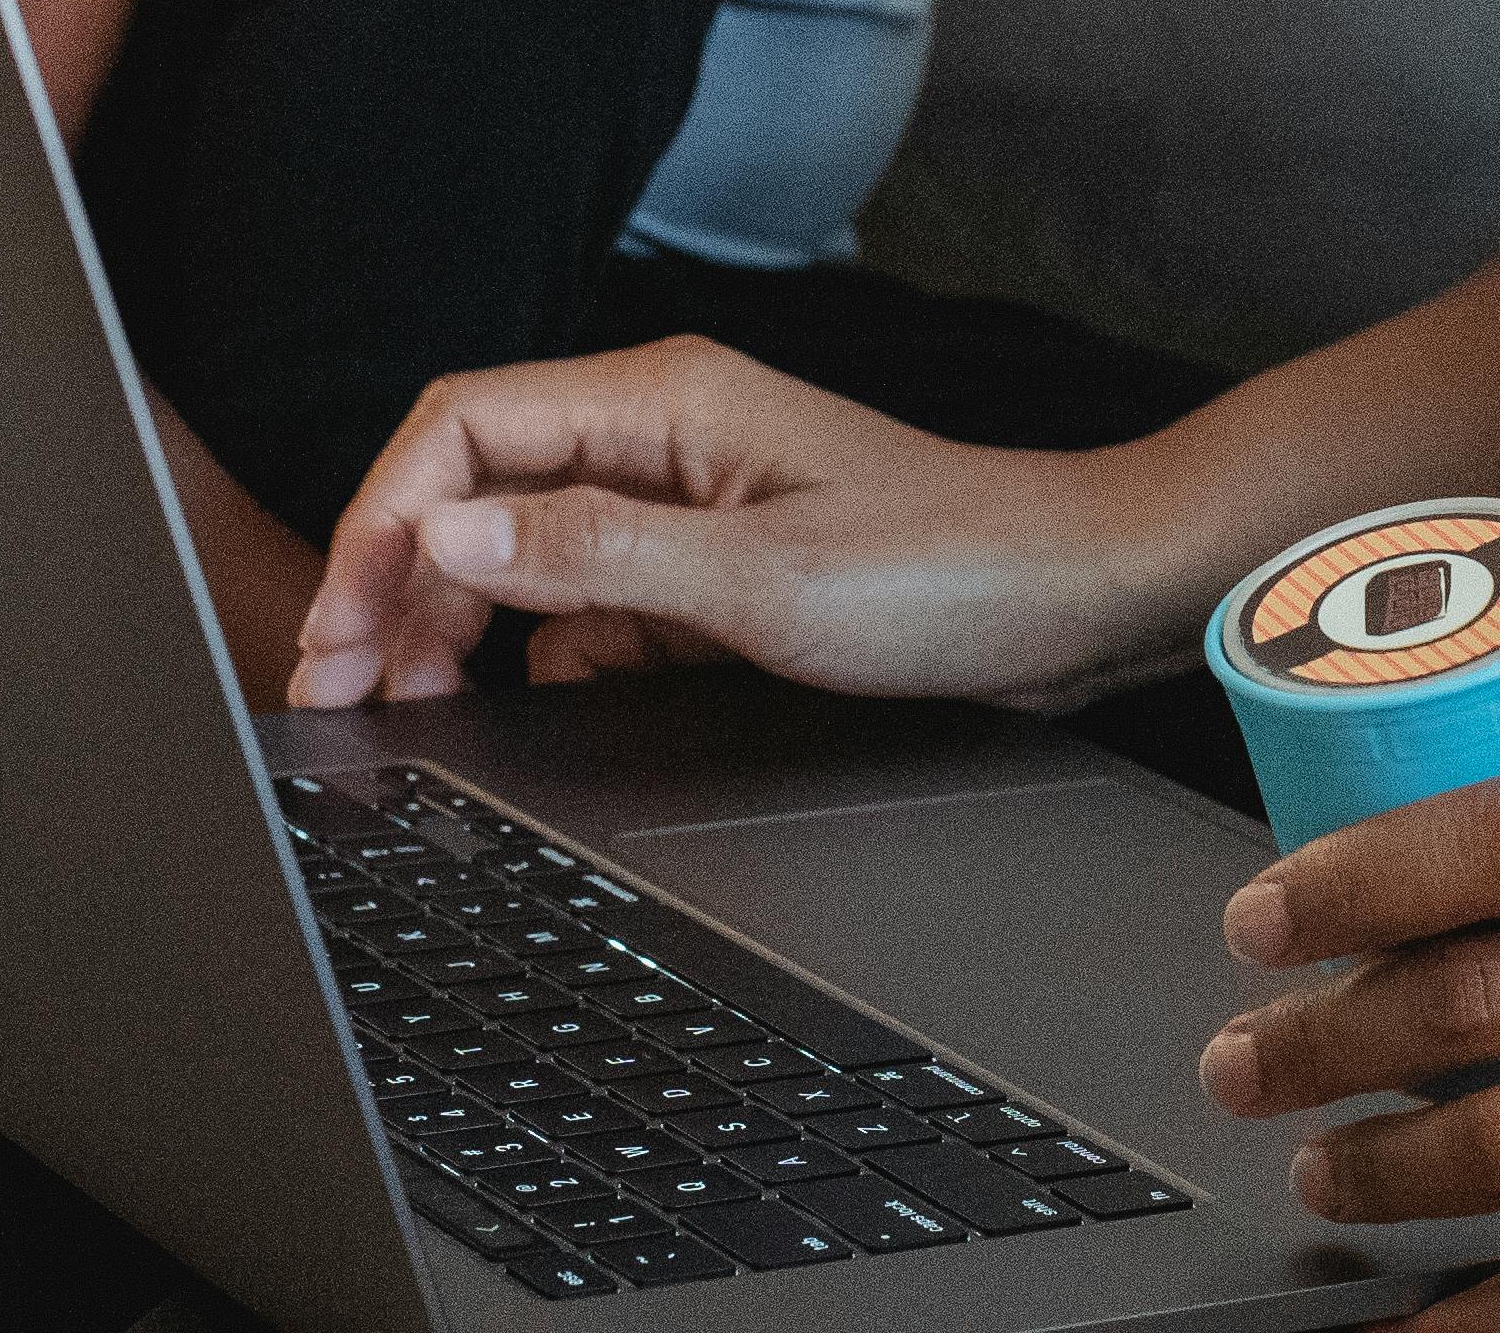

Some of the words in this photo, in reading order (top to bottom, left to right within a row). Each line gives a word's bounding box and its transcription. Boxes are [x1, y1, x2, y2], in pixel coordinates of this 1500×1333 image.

[921, 1063, 985, 1097] command
[999, 1105, 1043, 1129] option
[1056, 1140, 1107, 1165] control
[1150, 1190, 1170, 1201] fn
[884, 1199, 915, 1219] lock
[1021, 1198, 1058, 1216] shift
[910, 1212, 944, 1233] caps
[801, 1236, 829, 1252] tab
